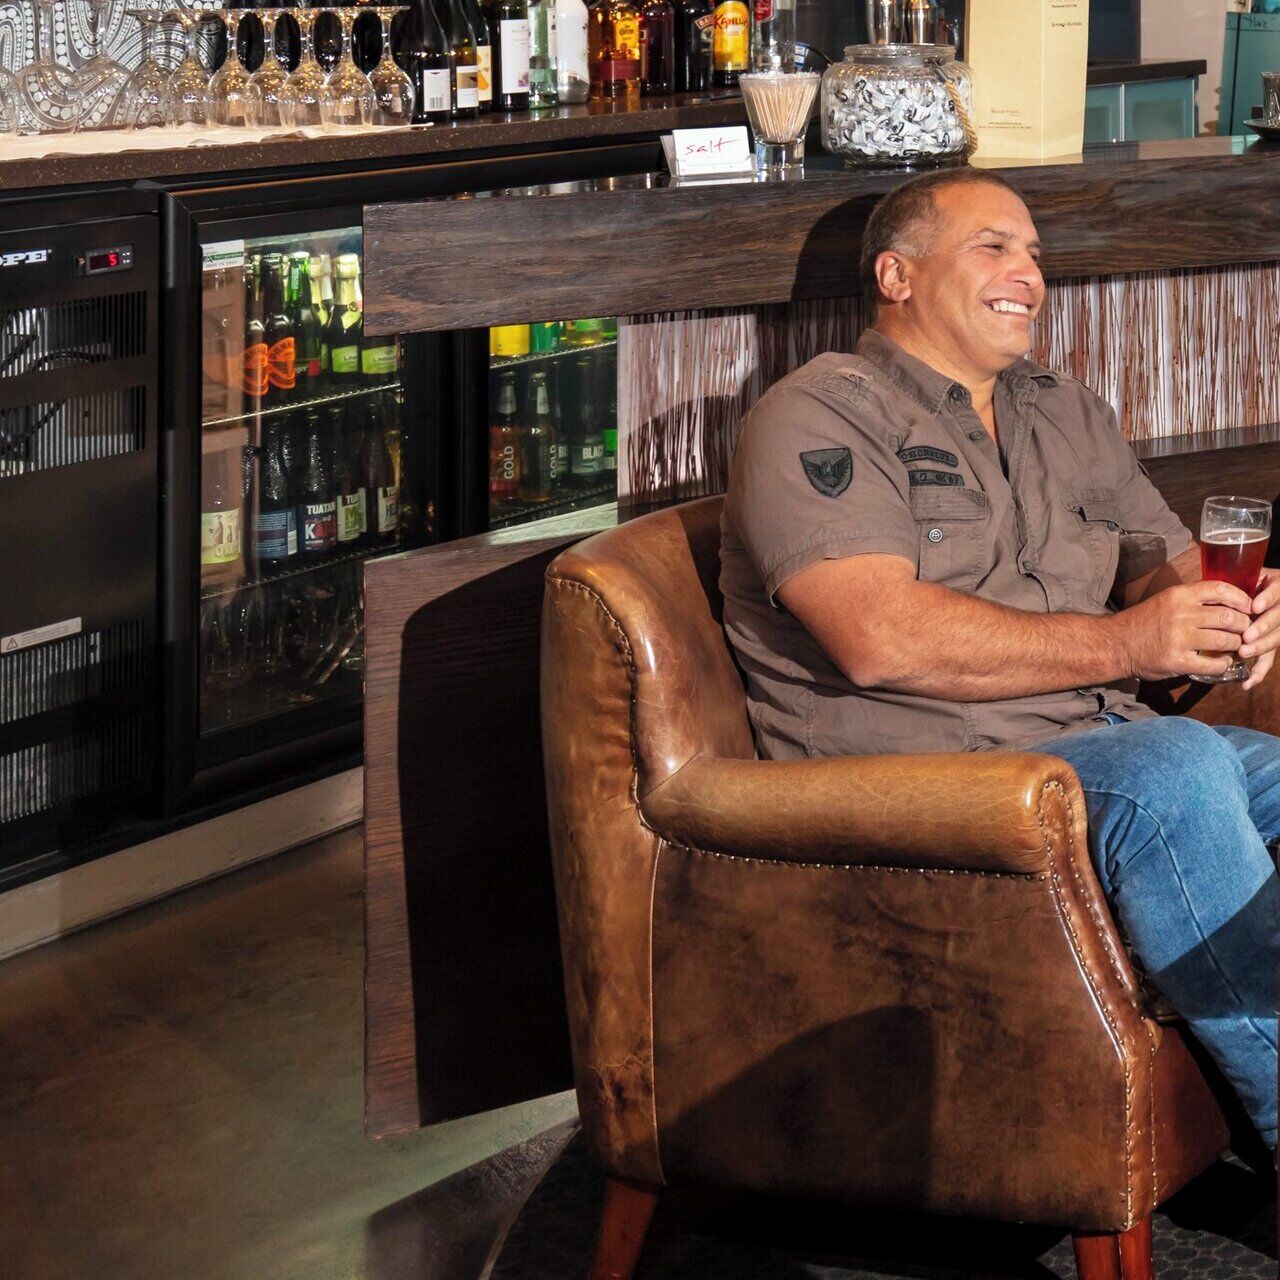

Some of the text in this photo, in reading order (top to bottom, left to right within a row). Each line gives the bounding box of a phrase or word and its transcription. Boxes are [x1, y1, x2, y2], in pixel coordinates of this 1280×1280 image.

[685, 137, 741, 156] salt
[108, 253, 118, 266] 5
[504, 446, 514, 480] GOLD
